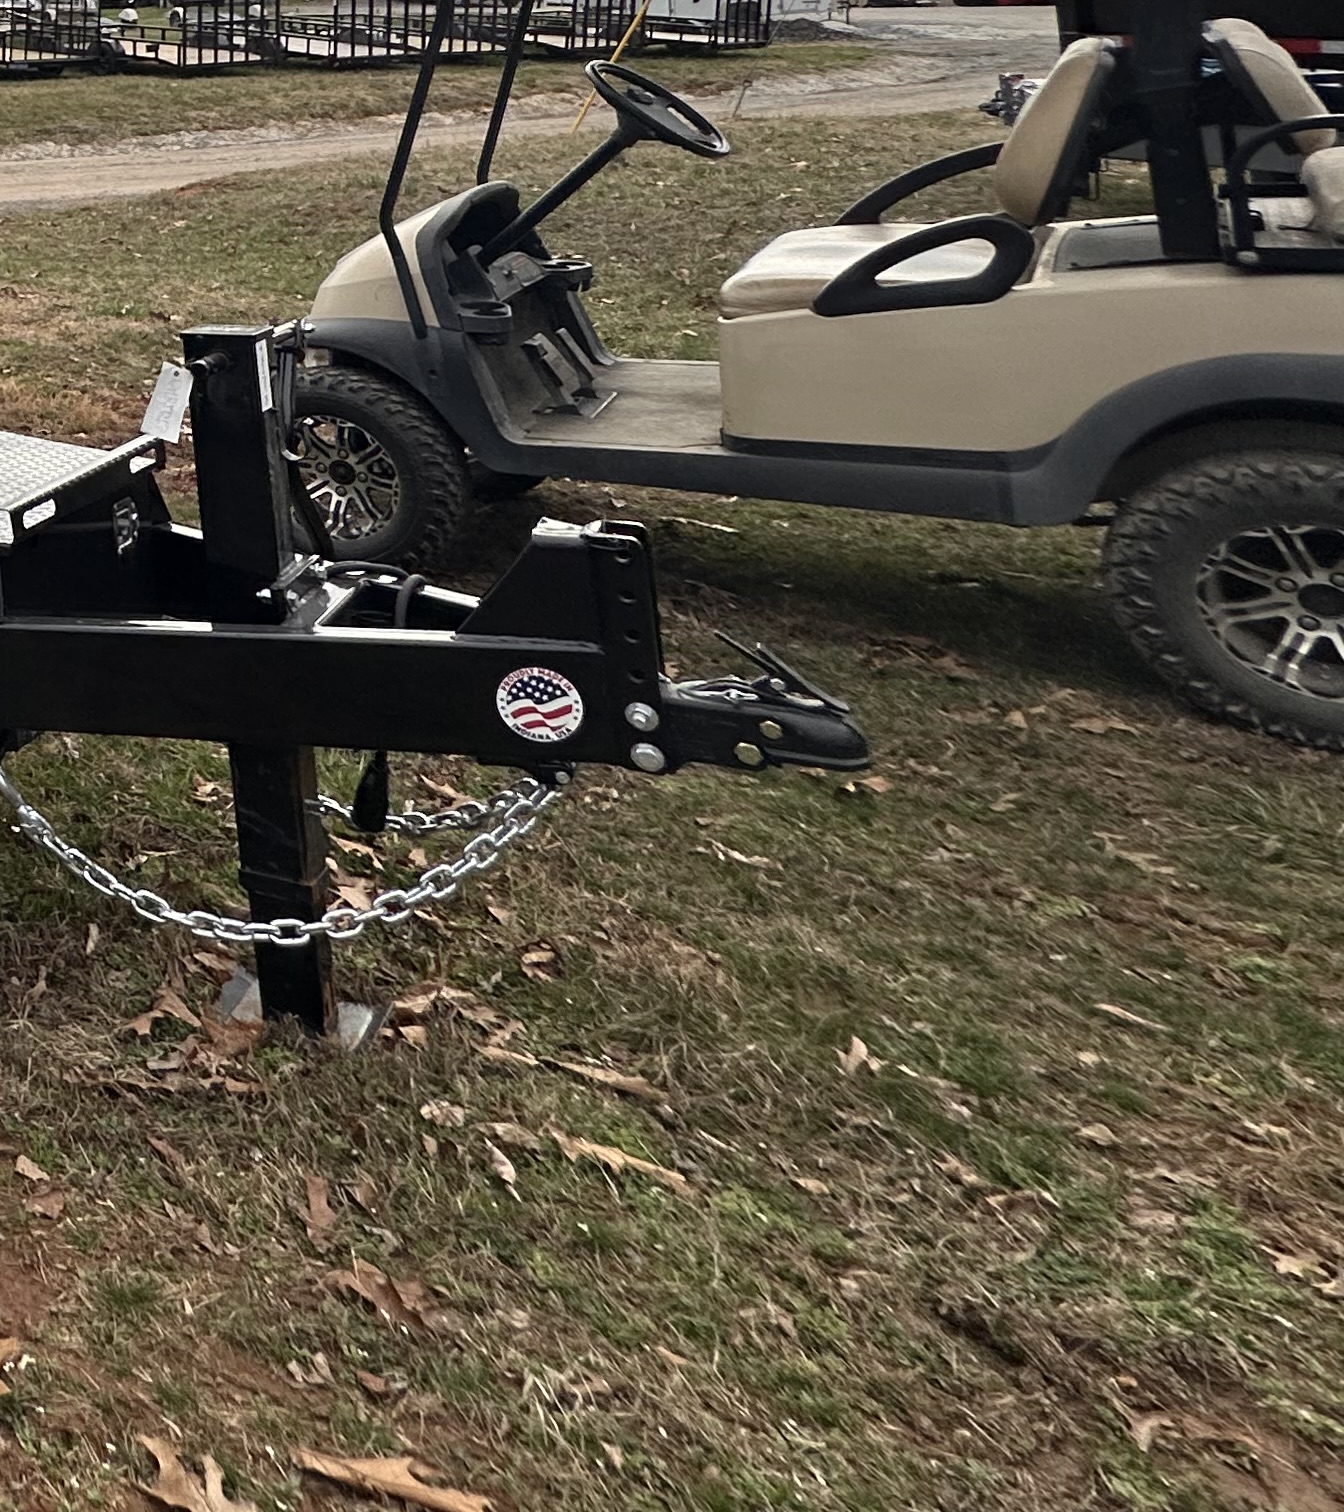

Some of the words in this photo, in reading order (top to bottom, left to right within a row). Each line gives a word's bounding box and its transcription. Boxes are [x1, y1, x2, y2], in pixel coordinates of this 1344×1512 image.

[501, 668, 534, 692] PROUDLY
[537, 668, 564, 683] MADE
[563, 682, 573, 692] IN
[512, 723, 552, 740] INDIANA
[555, 726, 572, 739] USA
